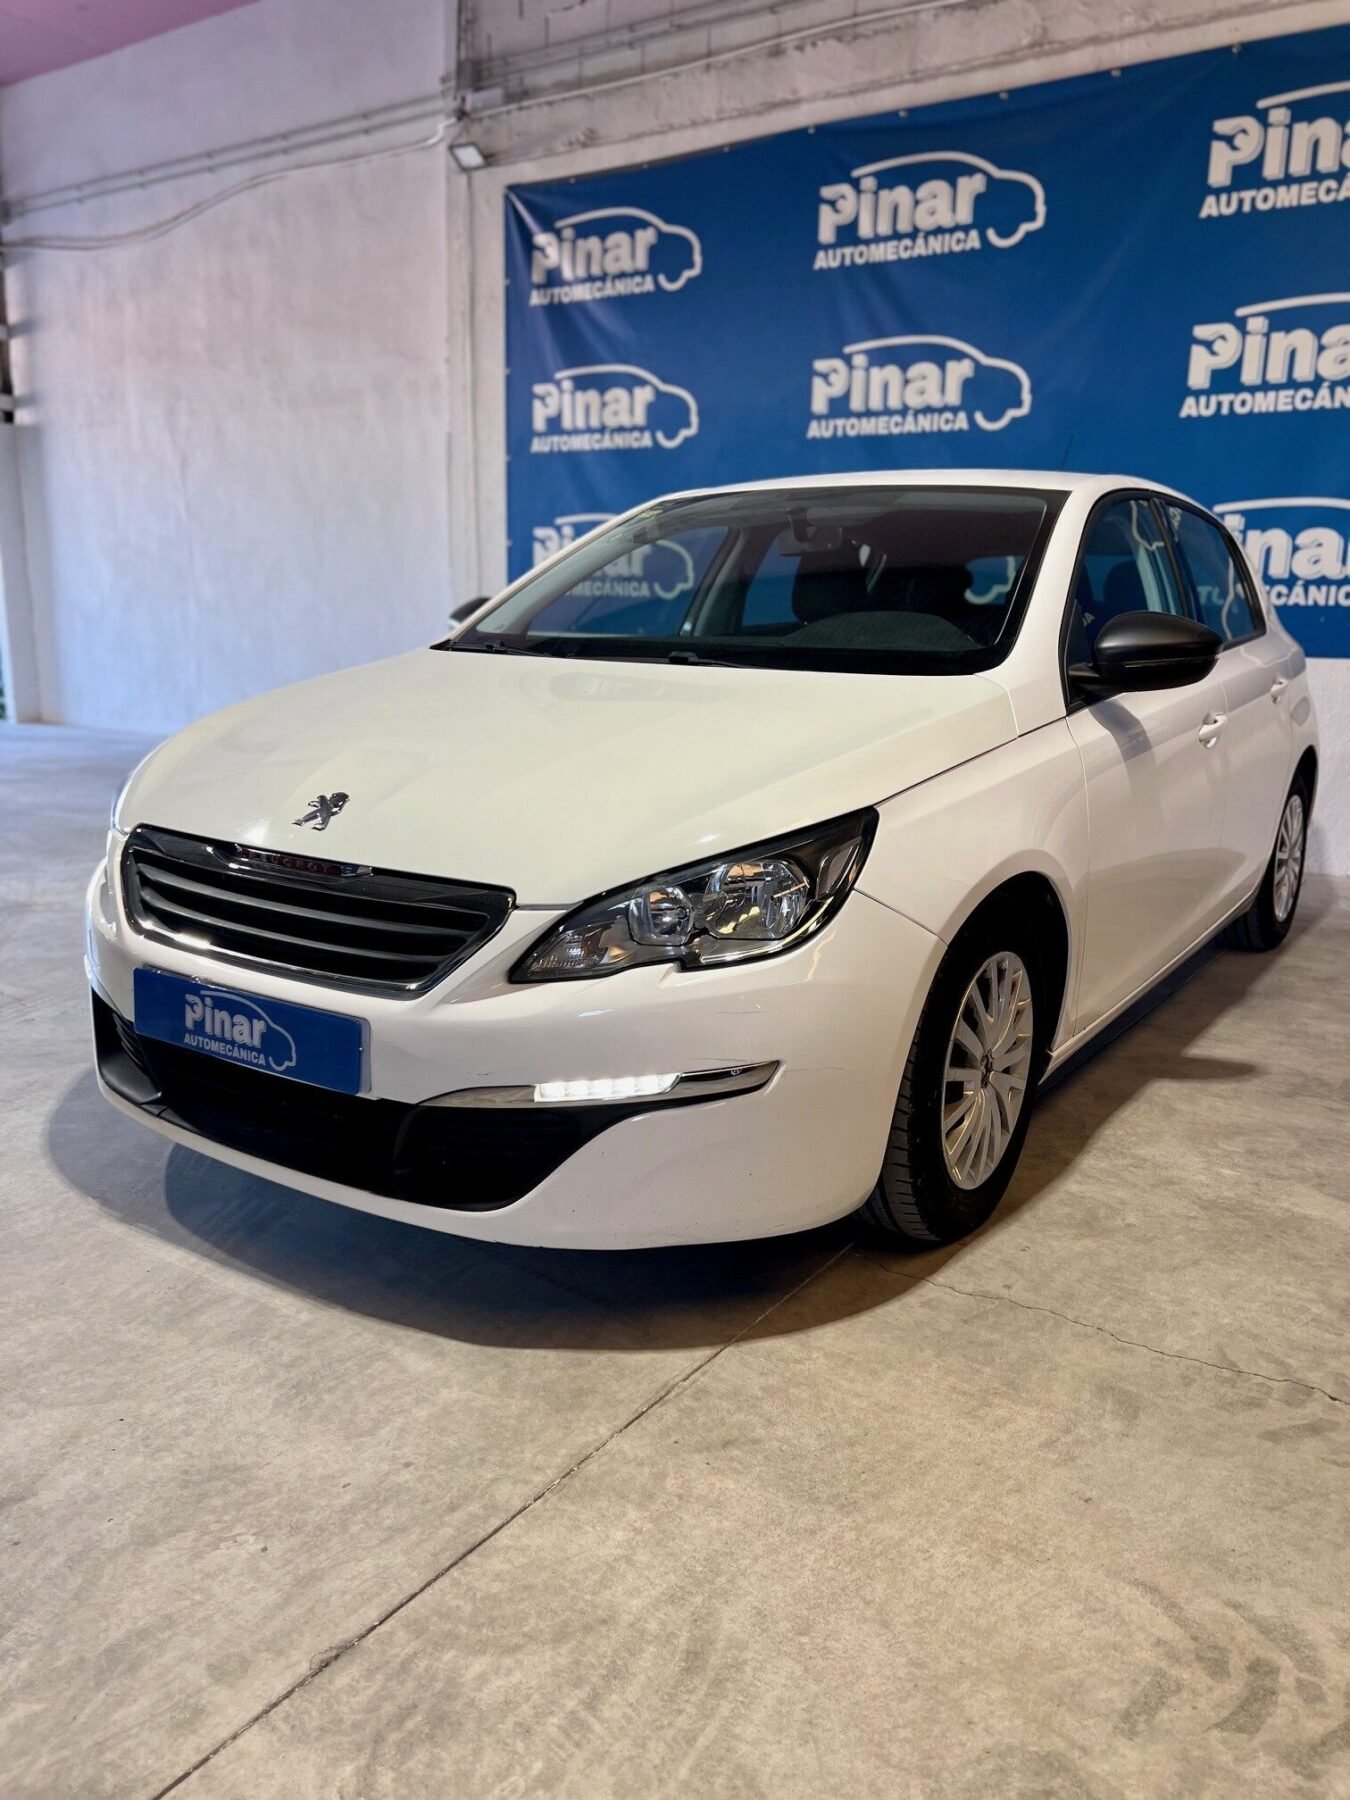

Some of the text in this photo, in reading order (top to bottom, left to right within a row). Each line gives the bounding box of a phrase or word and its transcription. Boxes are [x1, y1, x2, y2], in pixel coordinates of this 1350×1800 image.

[1207, 106, 1350, 188] Pin
[817, 172, 987, 245] Pinar
[531, 226, 658, 285] Pinar
[813, 229, 981, 270] AUTOMECÁNICA
[529, 274, 655, 307] AUTOMECÁNICA
[532, 378, 656, 433] Pinar
[810, 353, 975, 415] Pinar
[529, 430, 653, 454] AUTOMECÁNICA
[806, 411, 969, 439] AUTOMECÁNICA
[184, 993, 268, 1049] Pinar
[183, 1032, 267, 1066] AUTOMECÁNICA
